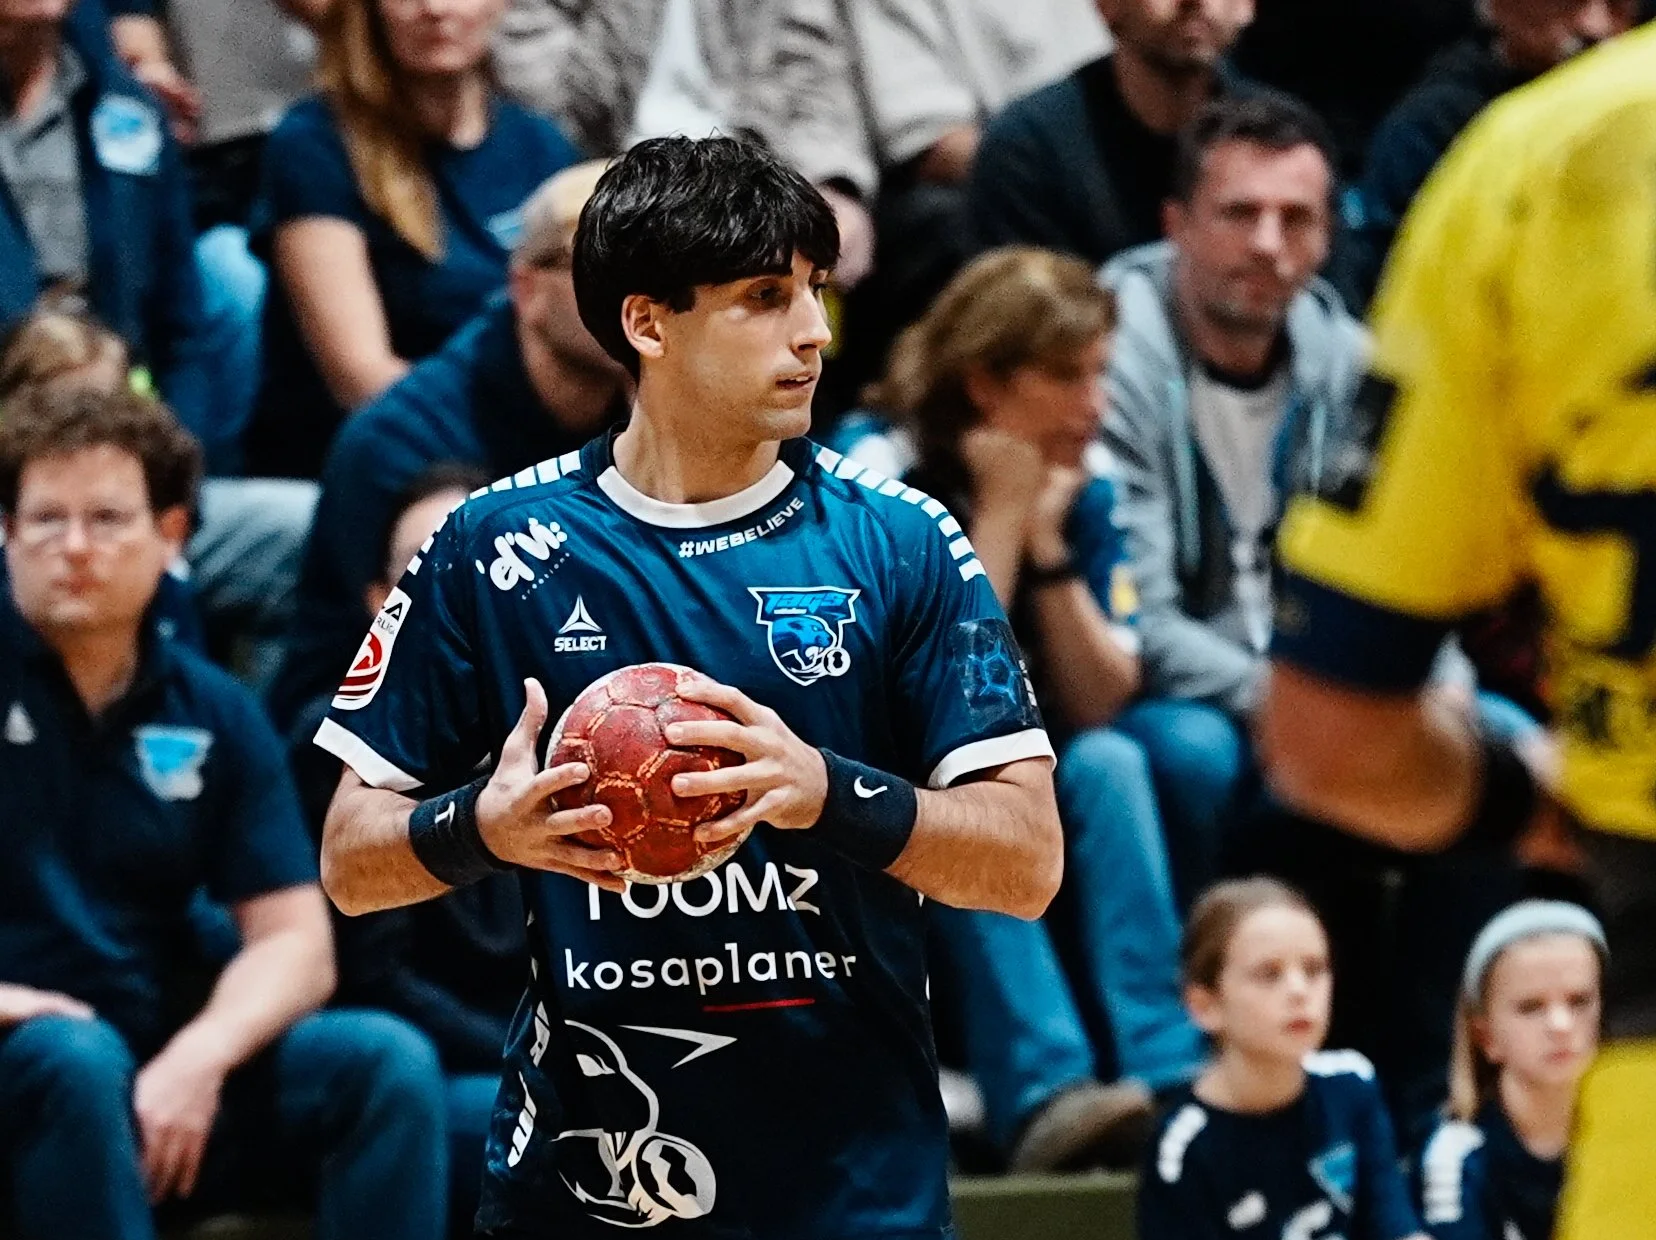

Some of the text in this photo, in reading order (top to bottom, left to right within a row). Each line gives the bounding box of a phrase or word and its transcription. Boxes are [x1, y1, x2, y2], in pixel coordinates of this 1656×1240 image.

[678, 497, 804, 558] #WEBELIEVE
[554, 634, 607, 653] SELECT
[565, 942, 857, 995] kosaplaner
